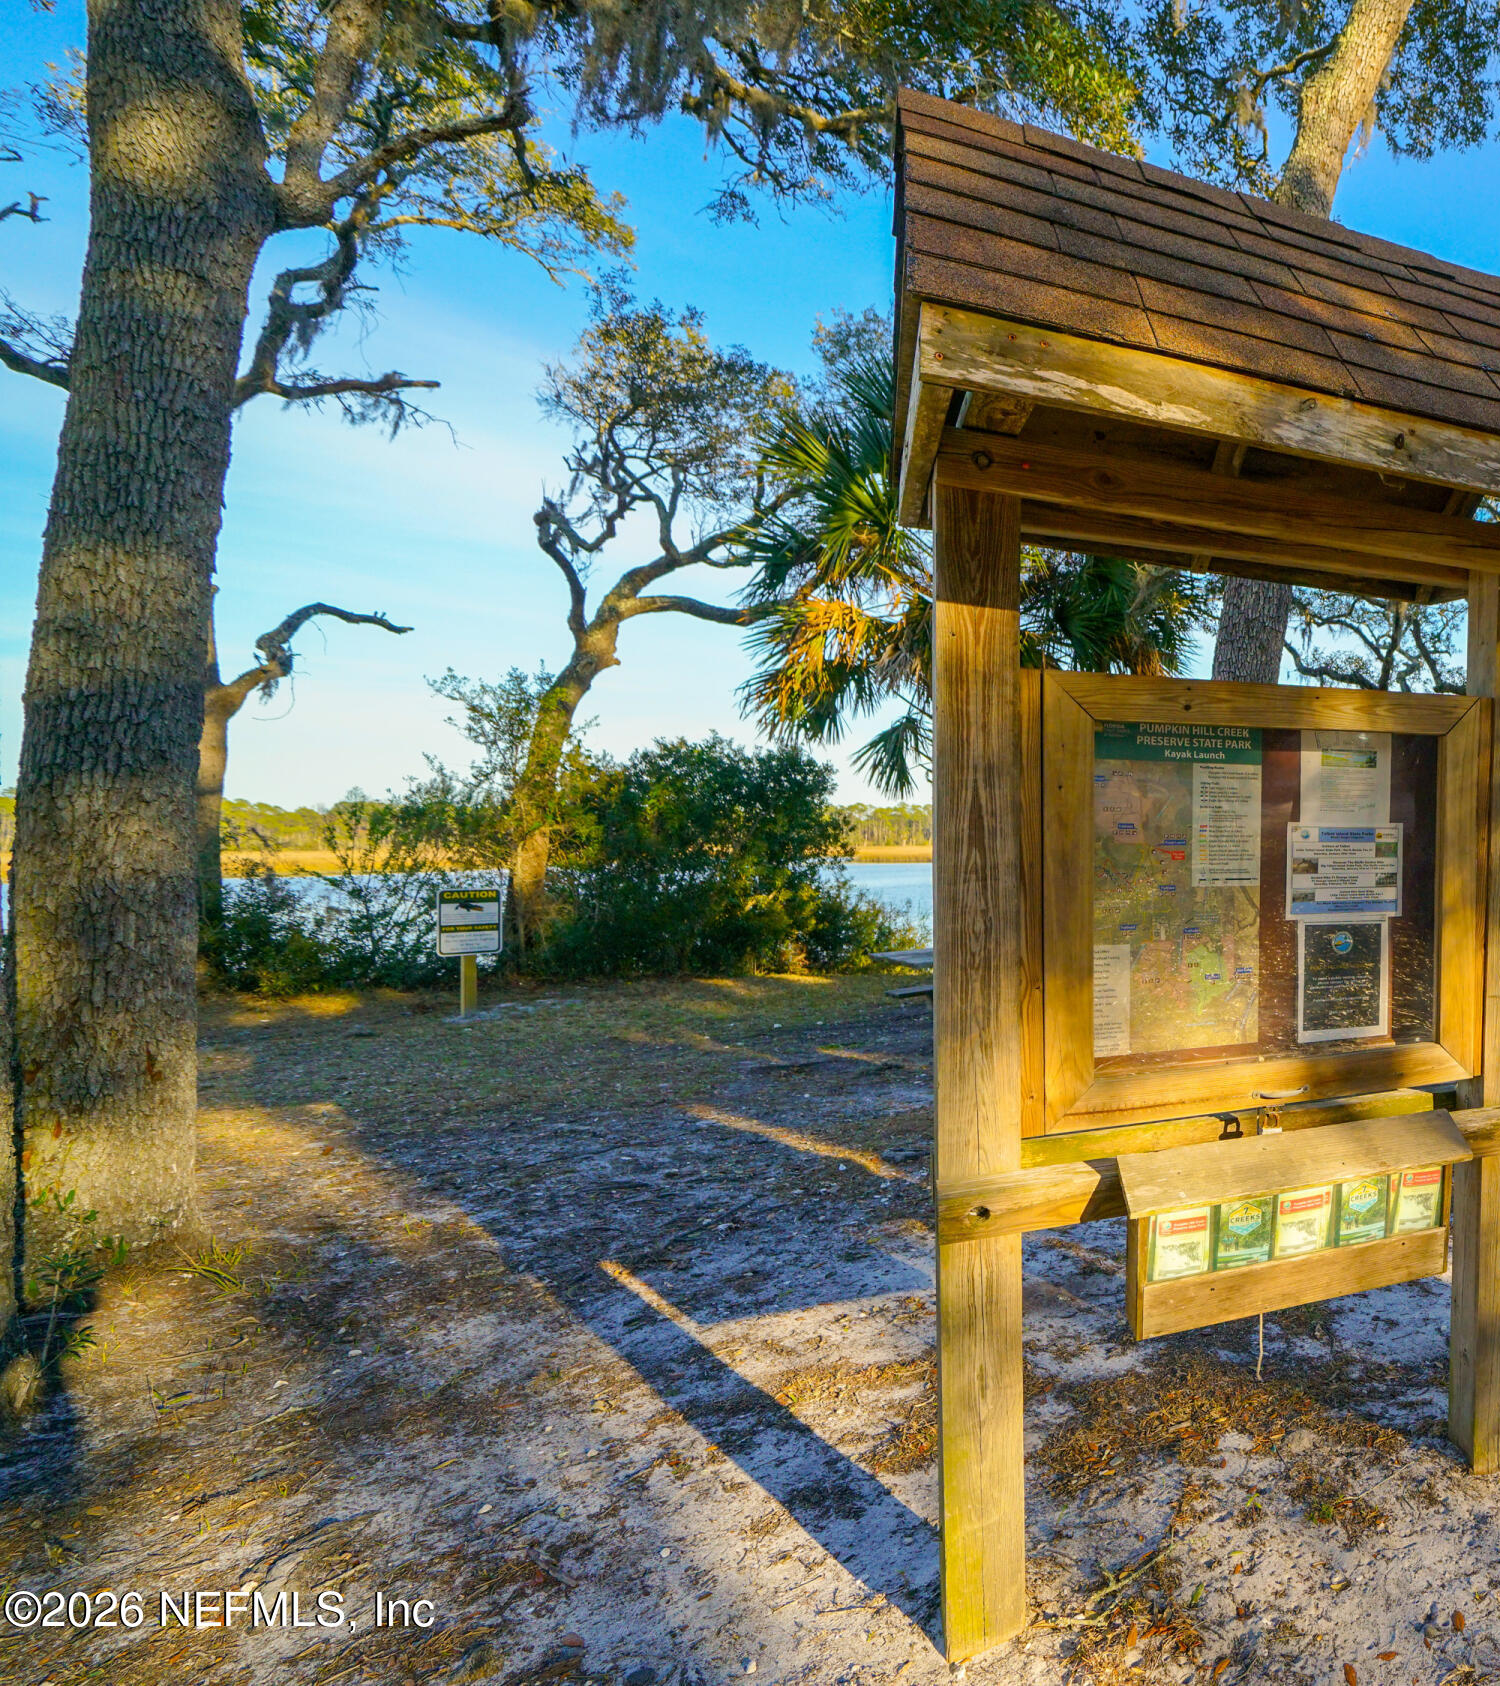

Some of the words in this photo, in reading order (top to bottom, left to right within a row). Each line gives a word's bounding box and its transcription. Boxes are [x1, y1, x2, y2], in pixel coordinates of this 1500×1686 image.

[1139, 723, 1190, 735] PUMPKIN
[1192, 725, 1215, 736] HILL
[1217, 727, 1249, 738] CREEK
[1136, 735, 1190, 747] PRESERVE
[1192, 738, 1223, 749] STATE
[1225, 739, 1252, 750] PARK
[1164, 749, 1192, 759] Kayak
[1193, 750, 1225, 759] Launch
[443, 891, 497, 899] CAUTION
[1350, 1191, 1377, 1202] CREEKS
[1230, 1214, 1261, 1224] CREEKS
